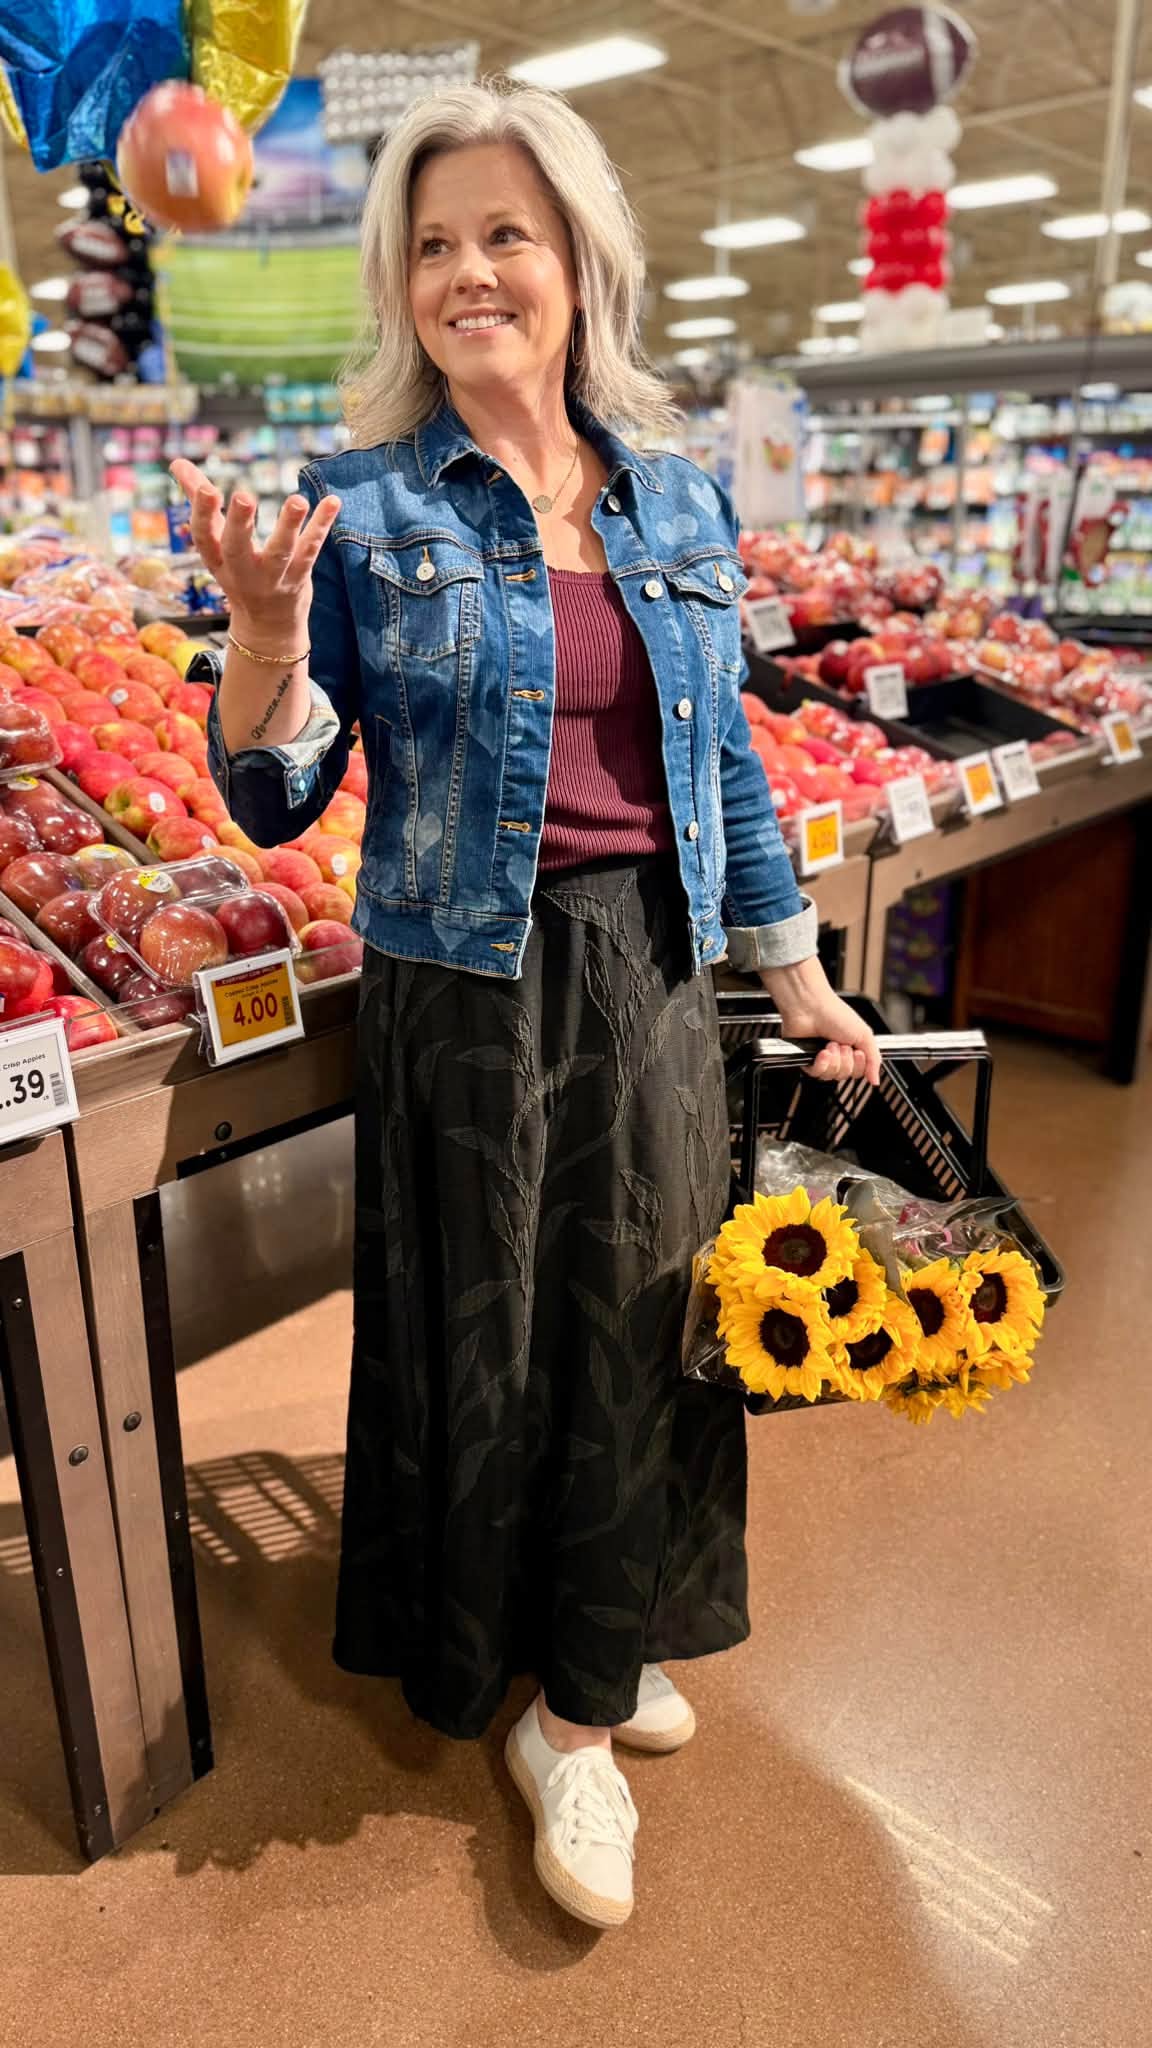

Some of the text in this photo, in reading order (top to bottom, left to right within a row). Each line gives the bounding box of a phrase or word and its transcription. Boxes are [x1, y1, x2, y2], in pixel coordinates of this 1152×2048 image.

[233, 992, 278, 1026] 4.00
[3, 1053, 46, 1070] Crisp Apples
[0, 1069, 45, 1110] .39
